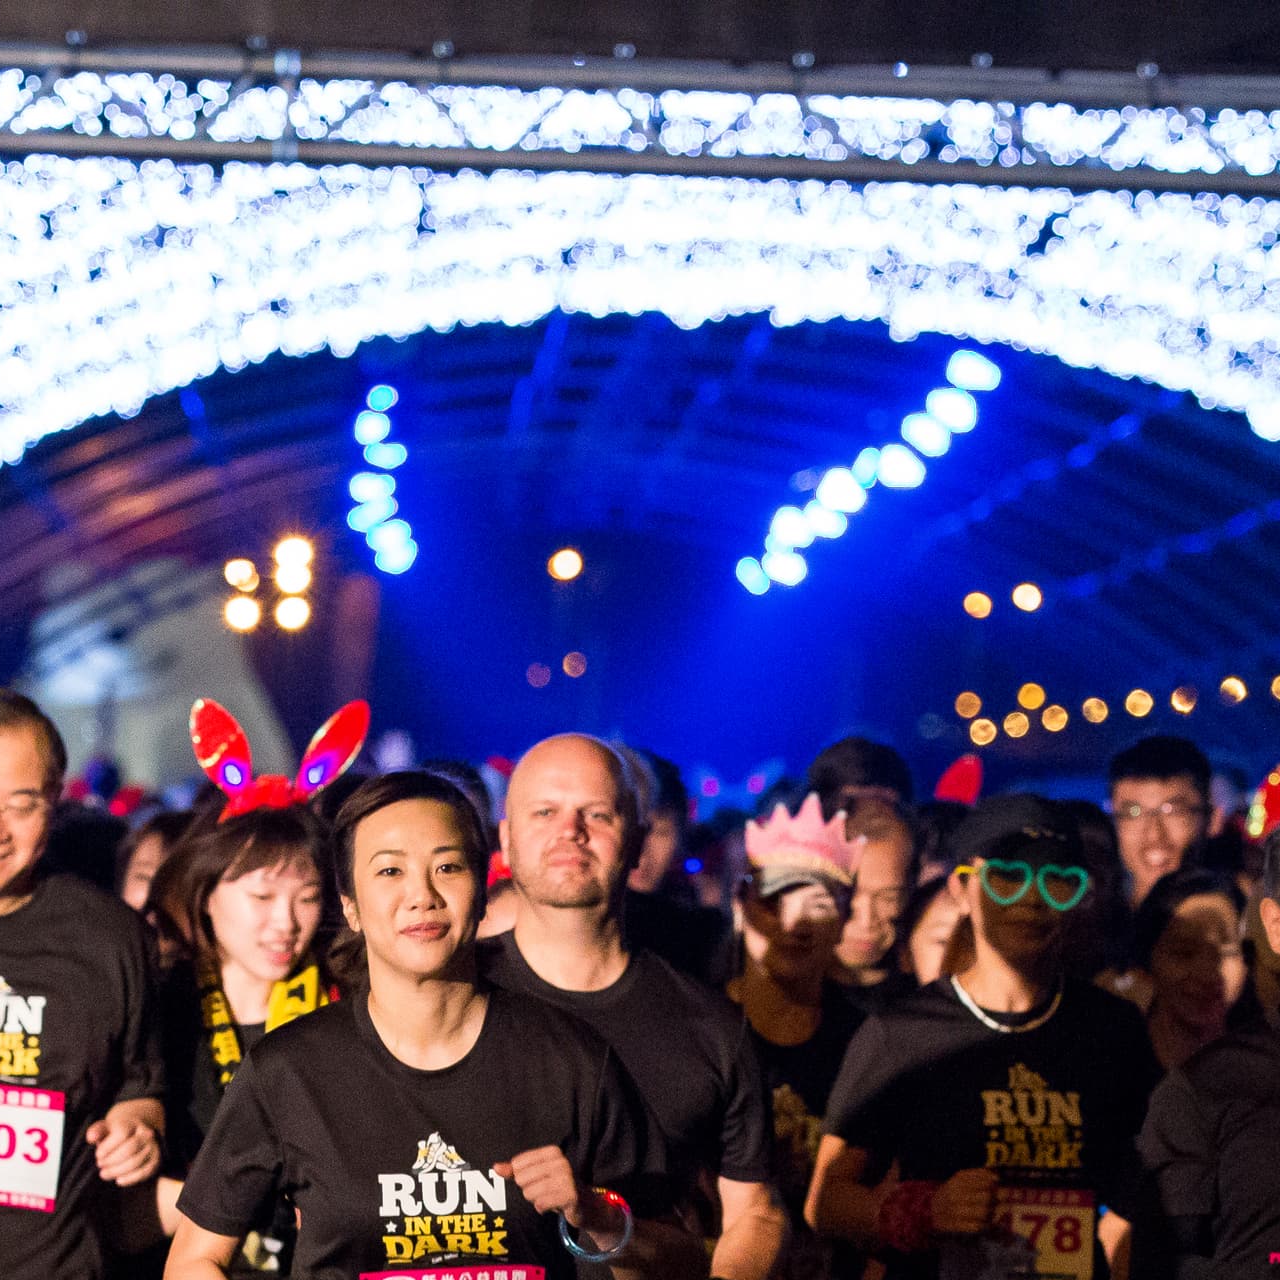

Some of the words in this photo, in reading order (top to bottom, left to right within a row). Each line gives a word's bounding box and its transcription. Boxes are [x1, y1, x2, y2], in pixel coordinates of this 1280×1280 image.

[981, 1090, 1083, 1126] RUN
[985, 1141, 1083, 1168] DARK
[377, 1168, 508, 1217] RUN
[404, 1216, 432, 1236] IN
[437, 1213, 487, 1234] THE
[382, 1231, 509, 1260] DARK
